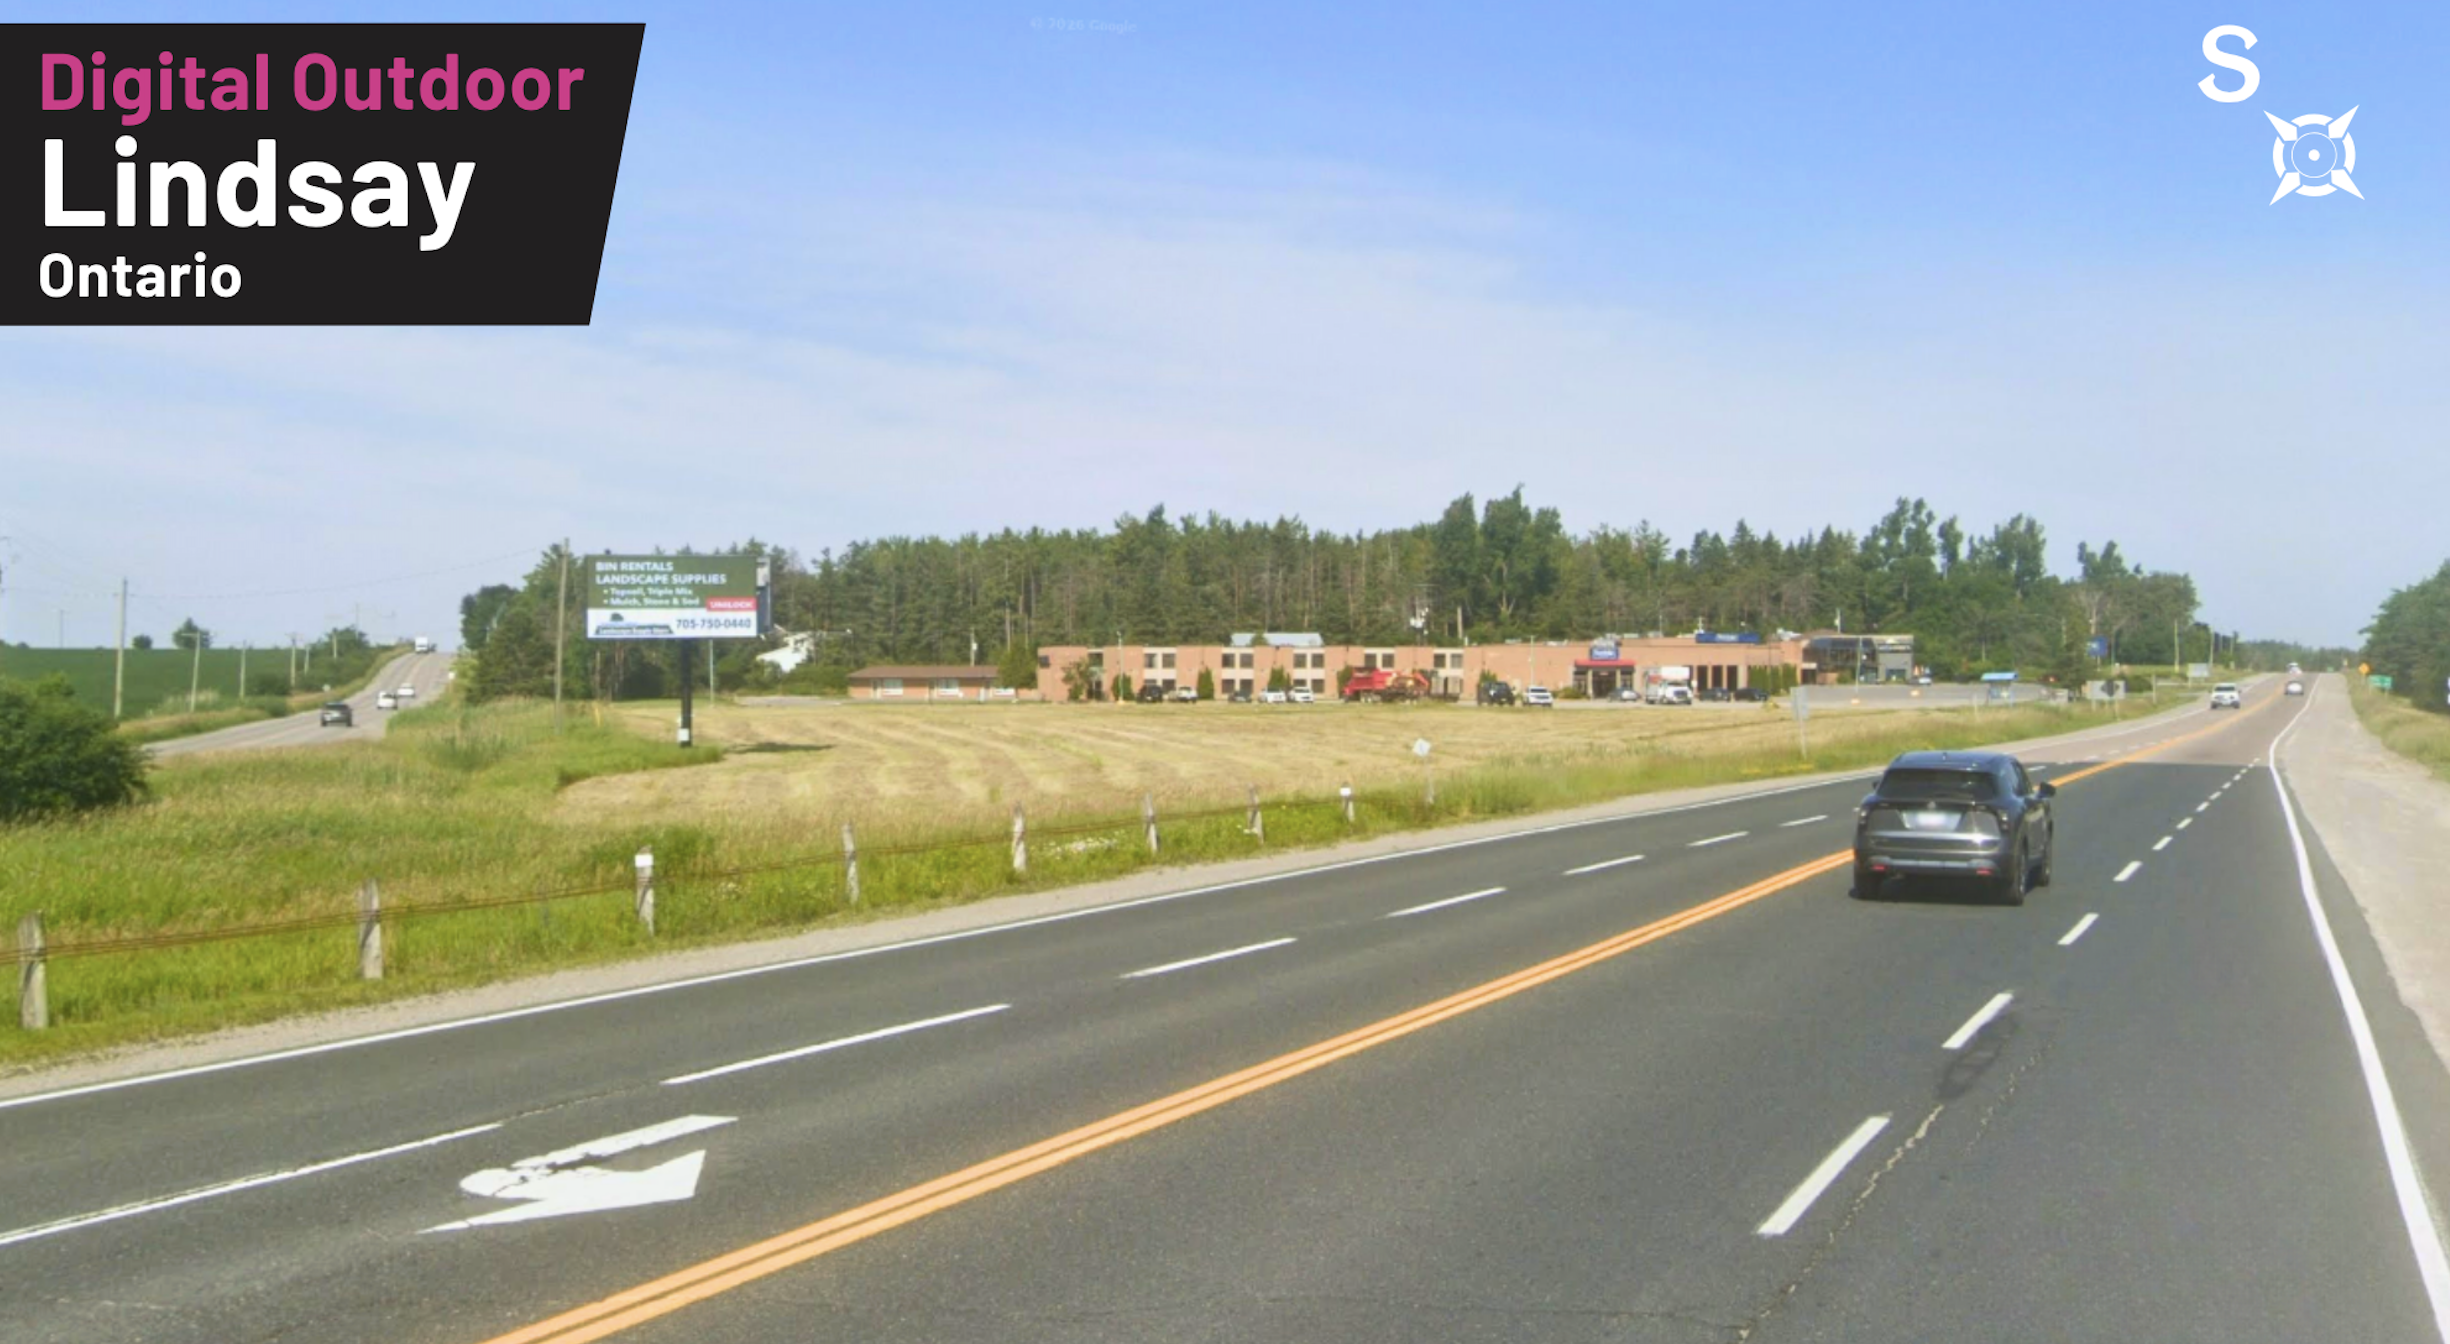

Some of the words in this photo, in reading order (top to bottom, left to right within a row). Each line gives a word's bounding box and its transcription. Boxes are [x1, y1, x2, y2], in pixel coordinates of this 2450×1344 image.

[595, 561, 618, 572] BIN
[620, 561, 674, 572] RENTALS
[595, 574, 669, 585] LANDSCAPE
[671, 573, 727, 585] SUPPLIES
[648, 587, 674, 597] Triple
[675, 587, 693, 596] Mix
[676, 618, 752, 630] 705-750-0440
